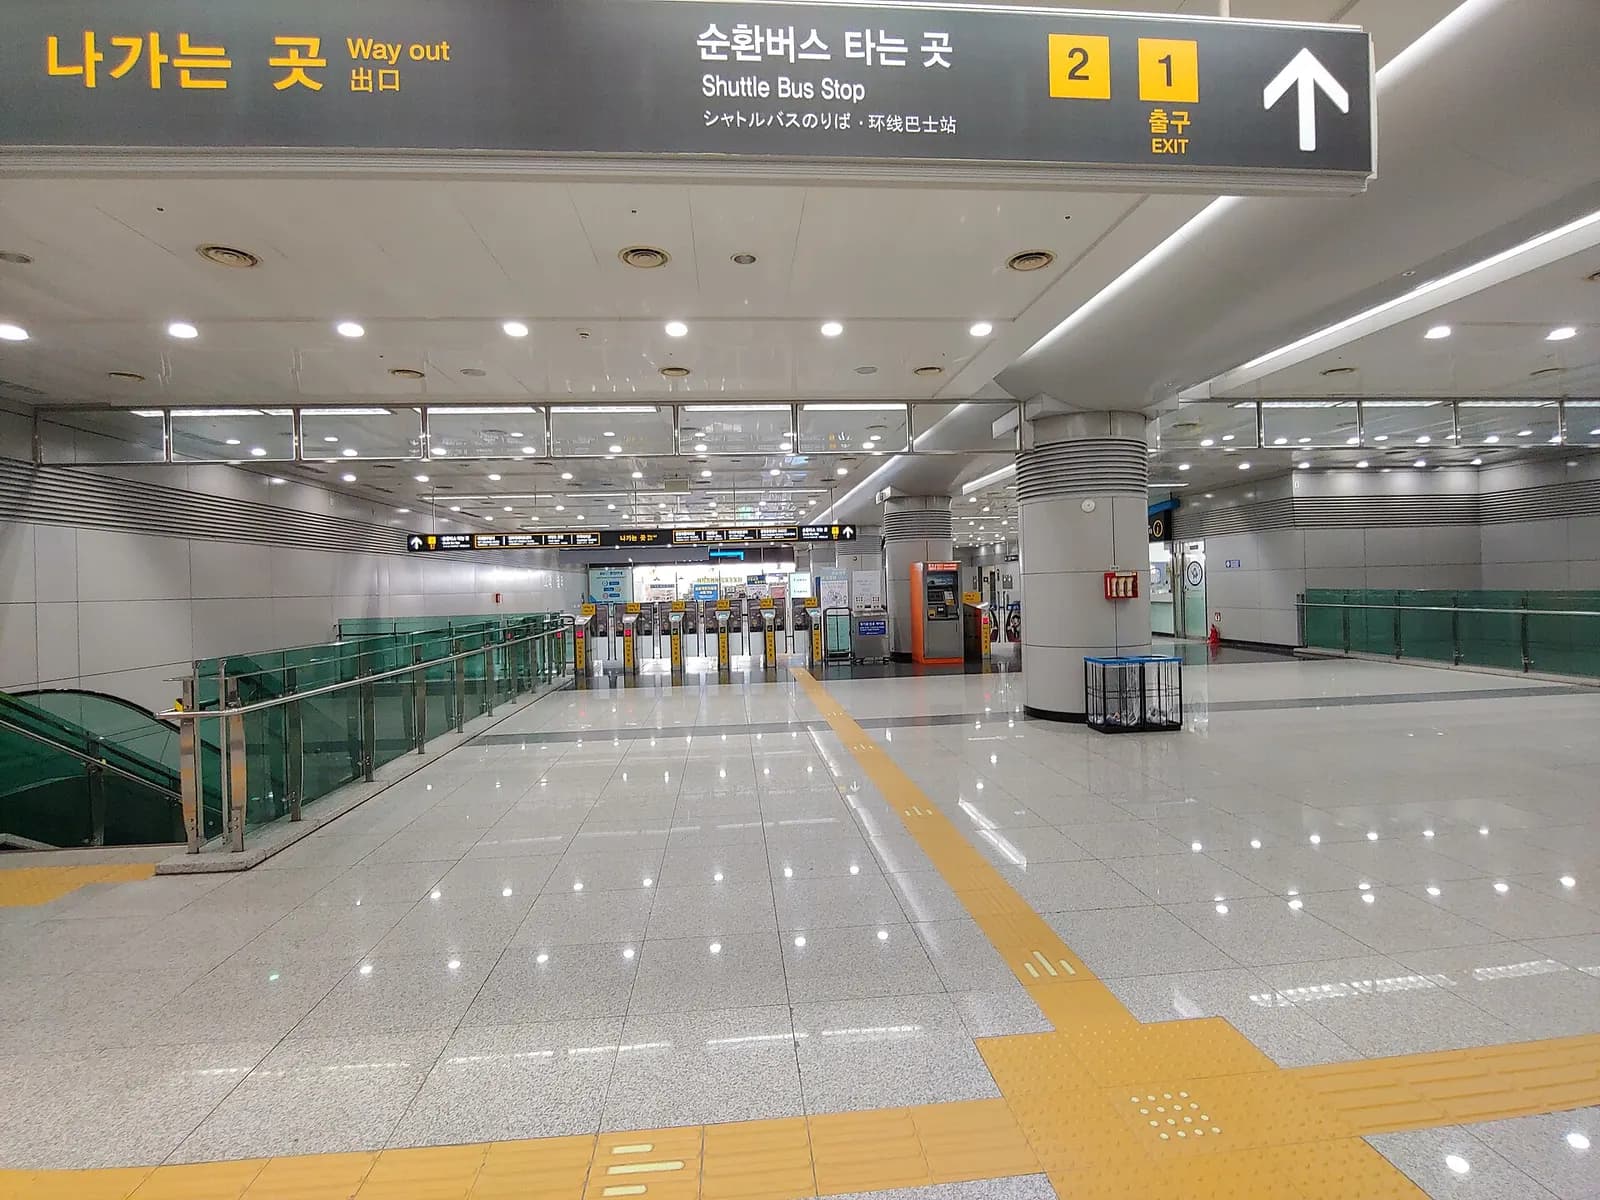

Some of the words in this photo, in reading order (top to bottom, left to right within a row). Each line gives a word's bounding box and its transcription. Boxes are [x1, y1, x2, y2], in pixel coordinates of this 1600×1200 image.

[346, 37, 401, 65] Way
[409, 40, 450, 61] out
[696, 23, 831, 63] 순환버스
[844, 28, 908, 66] 타는
[920, 31, 953, 68] 곳
[47, 31, 232, 90] 나가는
[268, 35, 327, 91] 곳
[1067, 47, 1090, 81] 2
[1158, 54, 1173, 87] 1
[349, 67, 400, 93] 出口
[702, 74, 770, 98] Shuttle
[777, 76, 814, 99] Bus
[821, 77, 866, 103] Stop
[703, 109, 851, 131] シャトルバスのりば
[868, 114, 957, 134] 环线巴士站
[1149, 108, 1192, 135] 출구
[1152, 138, 1189, 154] EXIT
